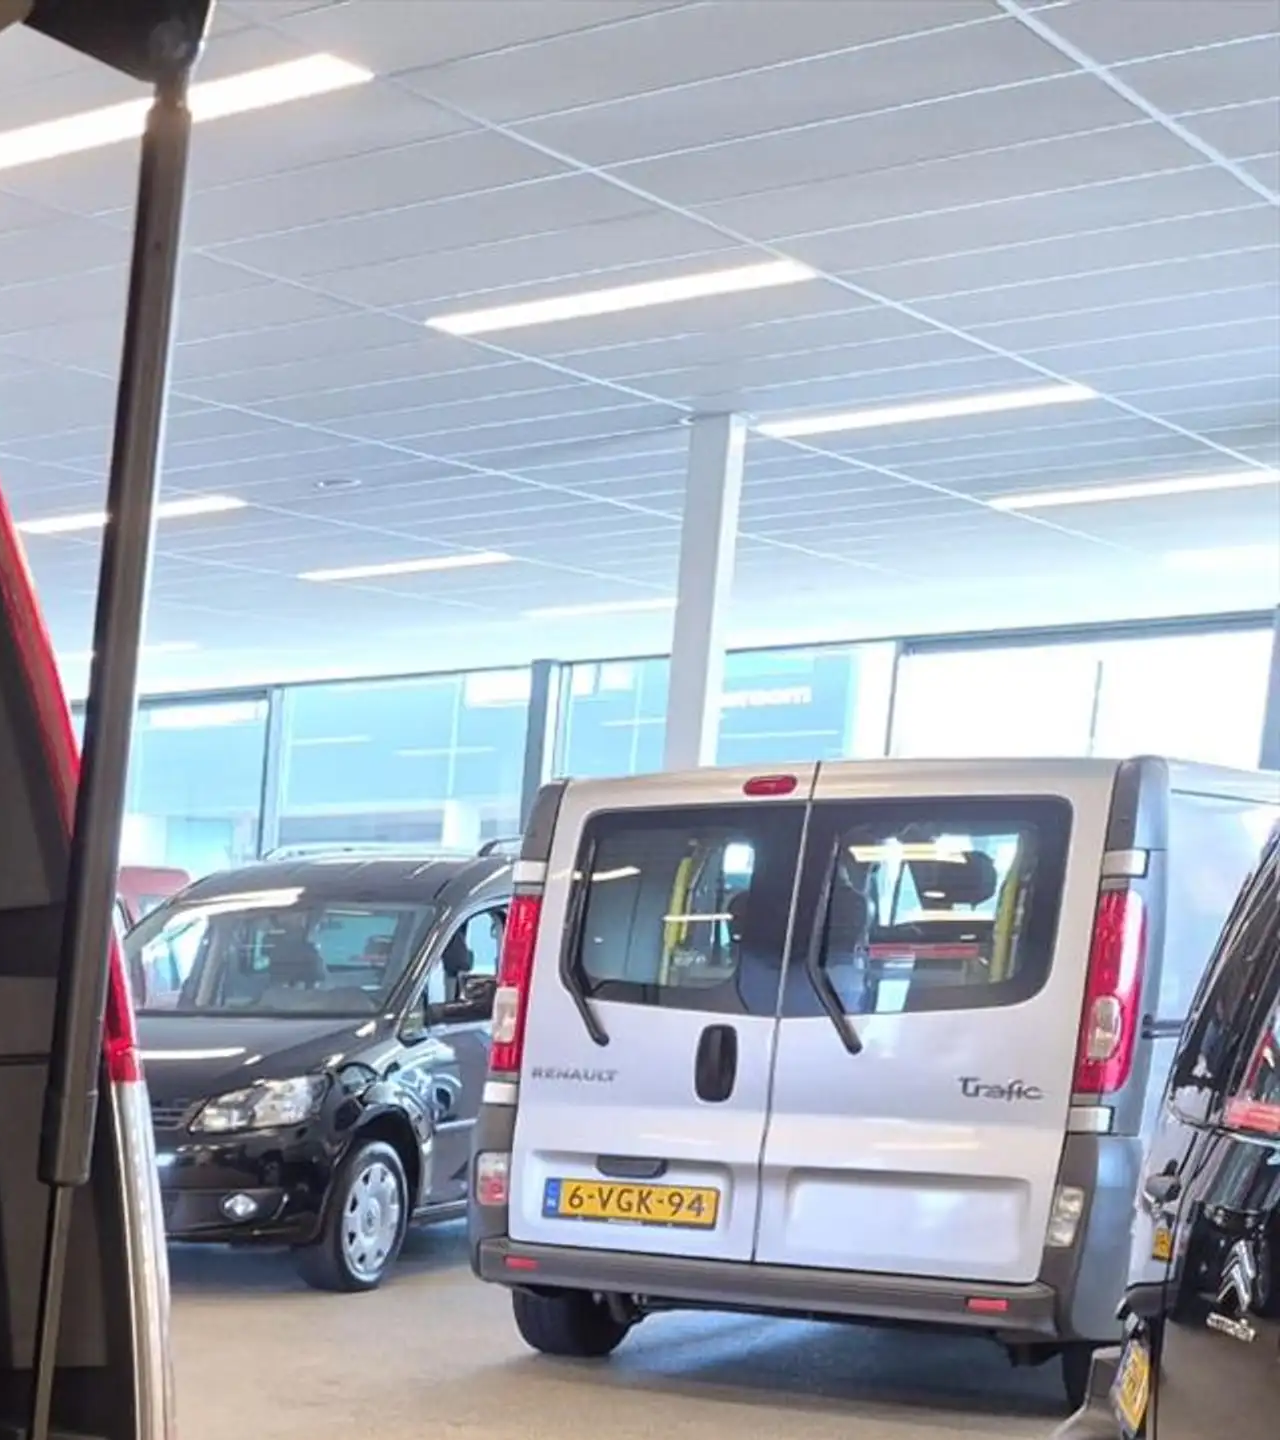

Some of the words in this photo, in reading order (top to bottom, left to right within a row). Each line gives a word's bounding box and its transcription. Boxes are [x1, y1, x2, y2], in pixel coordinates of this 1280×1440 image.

[531, 1067, 618, 1083] RENAULT
[958, 1076, 1044, 1101] Trafic
[568, 1185, 705, 1217] 6-VGK-94
